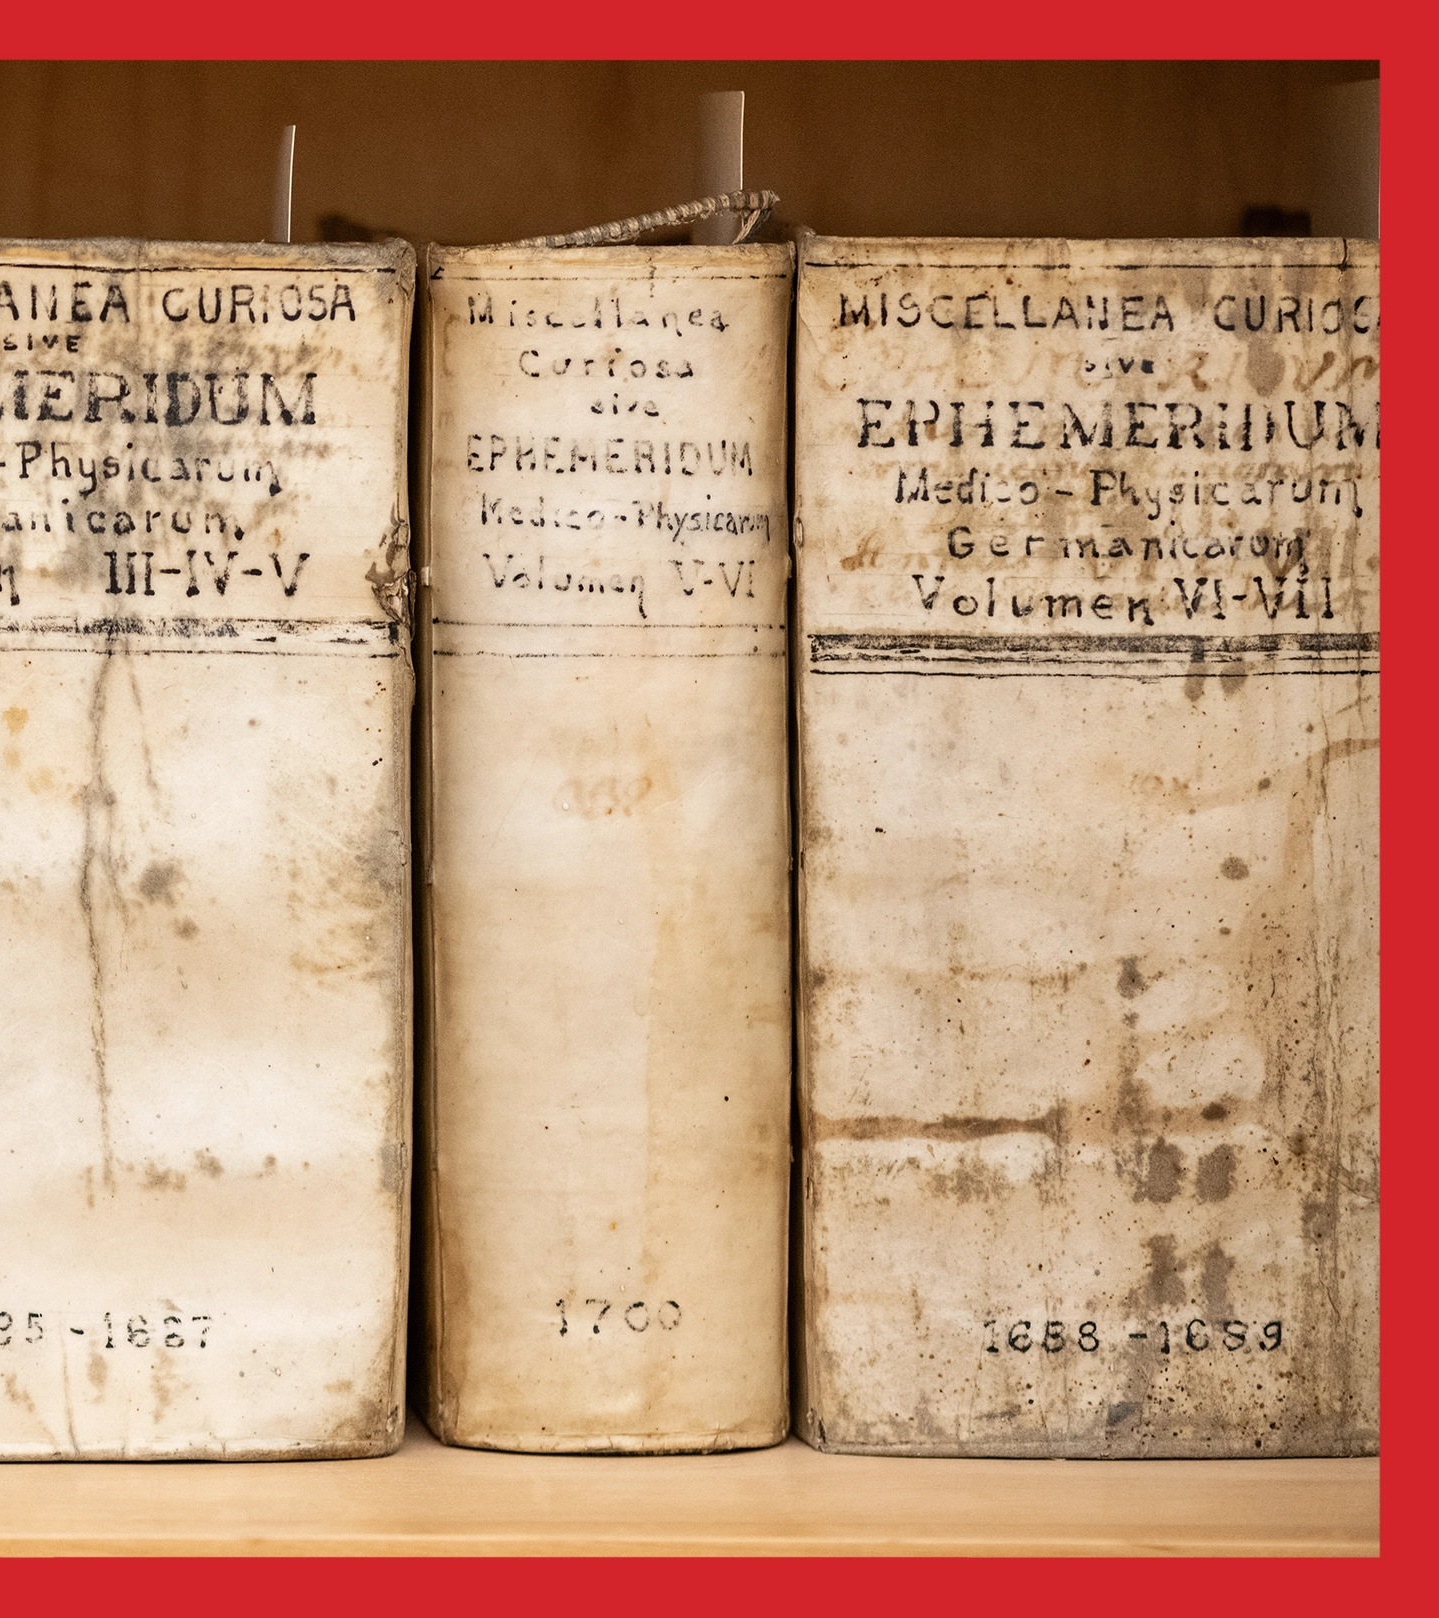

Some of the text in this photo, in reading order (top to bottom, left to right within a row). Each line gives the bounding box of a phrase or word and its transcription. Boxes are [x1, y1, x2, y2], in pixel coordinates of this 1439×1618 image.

[163, 285, 356, 325] CURIOSA
[468, 296, 730, 337] Miscellanea
[839, 293, 1380, 334] MISCELLANEA CURIOS
[519, 347, 694, 378] Curiosa
[857, 398, 1380, 451] EPHEMERIDUM
[467, 434, 753, 476] EPHEMERIDUM
[947, 526, 1312, 574] Germanicarum
[104, 550, 311, 597] III-IV-V
[483, 552, 648, 618] Volumen
[912, 575, 1155, 626] Volumen
[556, 1298, 682, 1337] 1700
